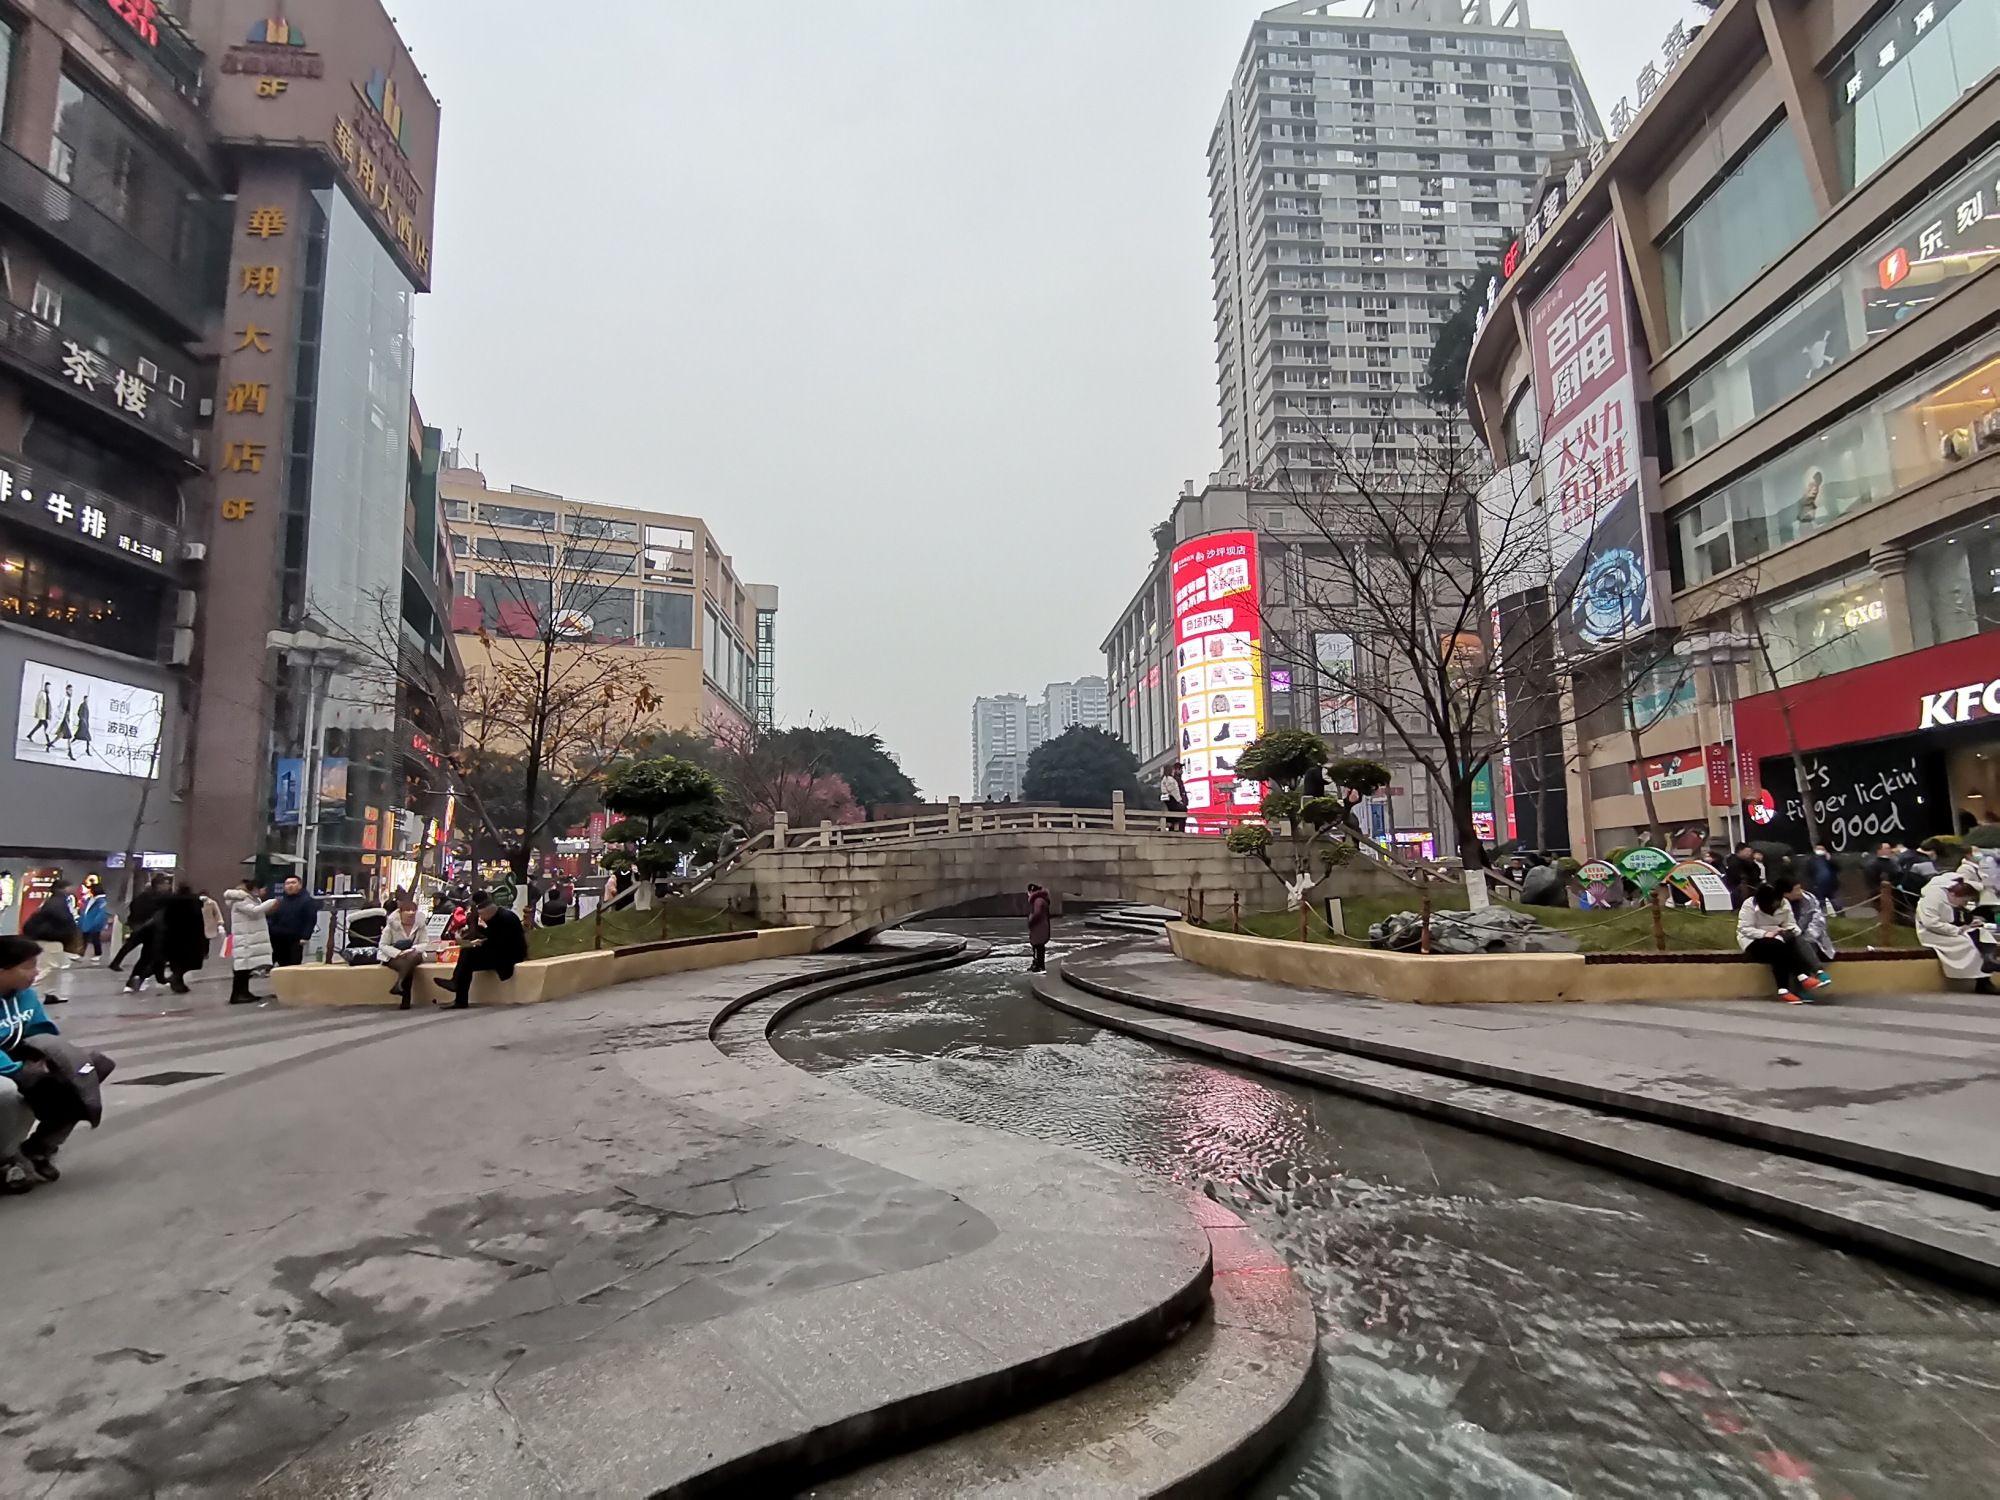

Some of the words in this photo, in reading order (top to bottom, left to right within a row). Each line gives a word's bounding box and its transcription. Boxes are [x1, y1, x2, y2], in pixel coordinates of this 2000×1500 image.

[256, 77, 288, 97] 6F
[1919, 178, 2000, 261] 乐刻
[1546, 270, 1608, 369] 百吉
[62, 341, 147, 420] 茶楼
[1552, 323, 1615, 418] 厨电
[1558, 399, 1622, 479] 大火力
[222, 498, 255, 521] 6F
[1206, 545, 1246, 559] 沙坪坝店
[1844, 600, 1884, 628] GXG
[107, 721, 138, 738] 波司登
[1786, 794, 1847, 824] figer
[1854, 756, 1917, 805] lickin'
[1831, 802, 1905, 851] good
